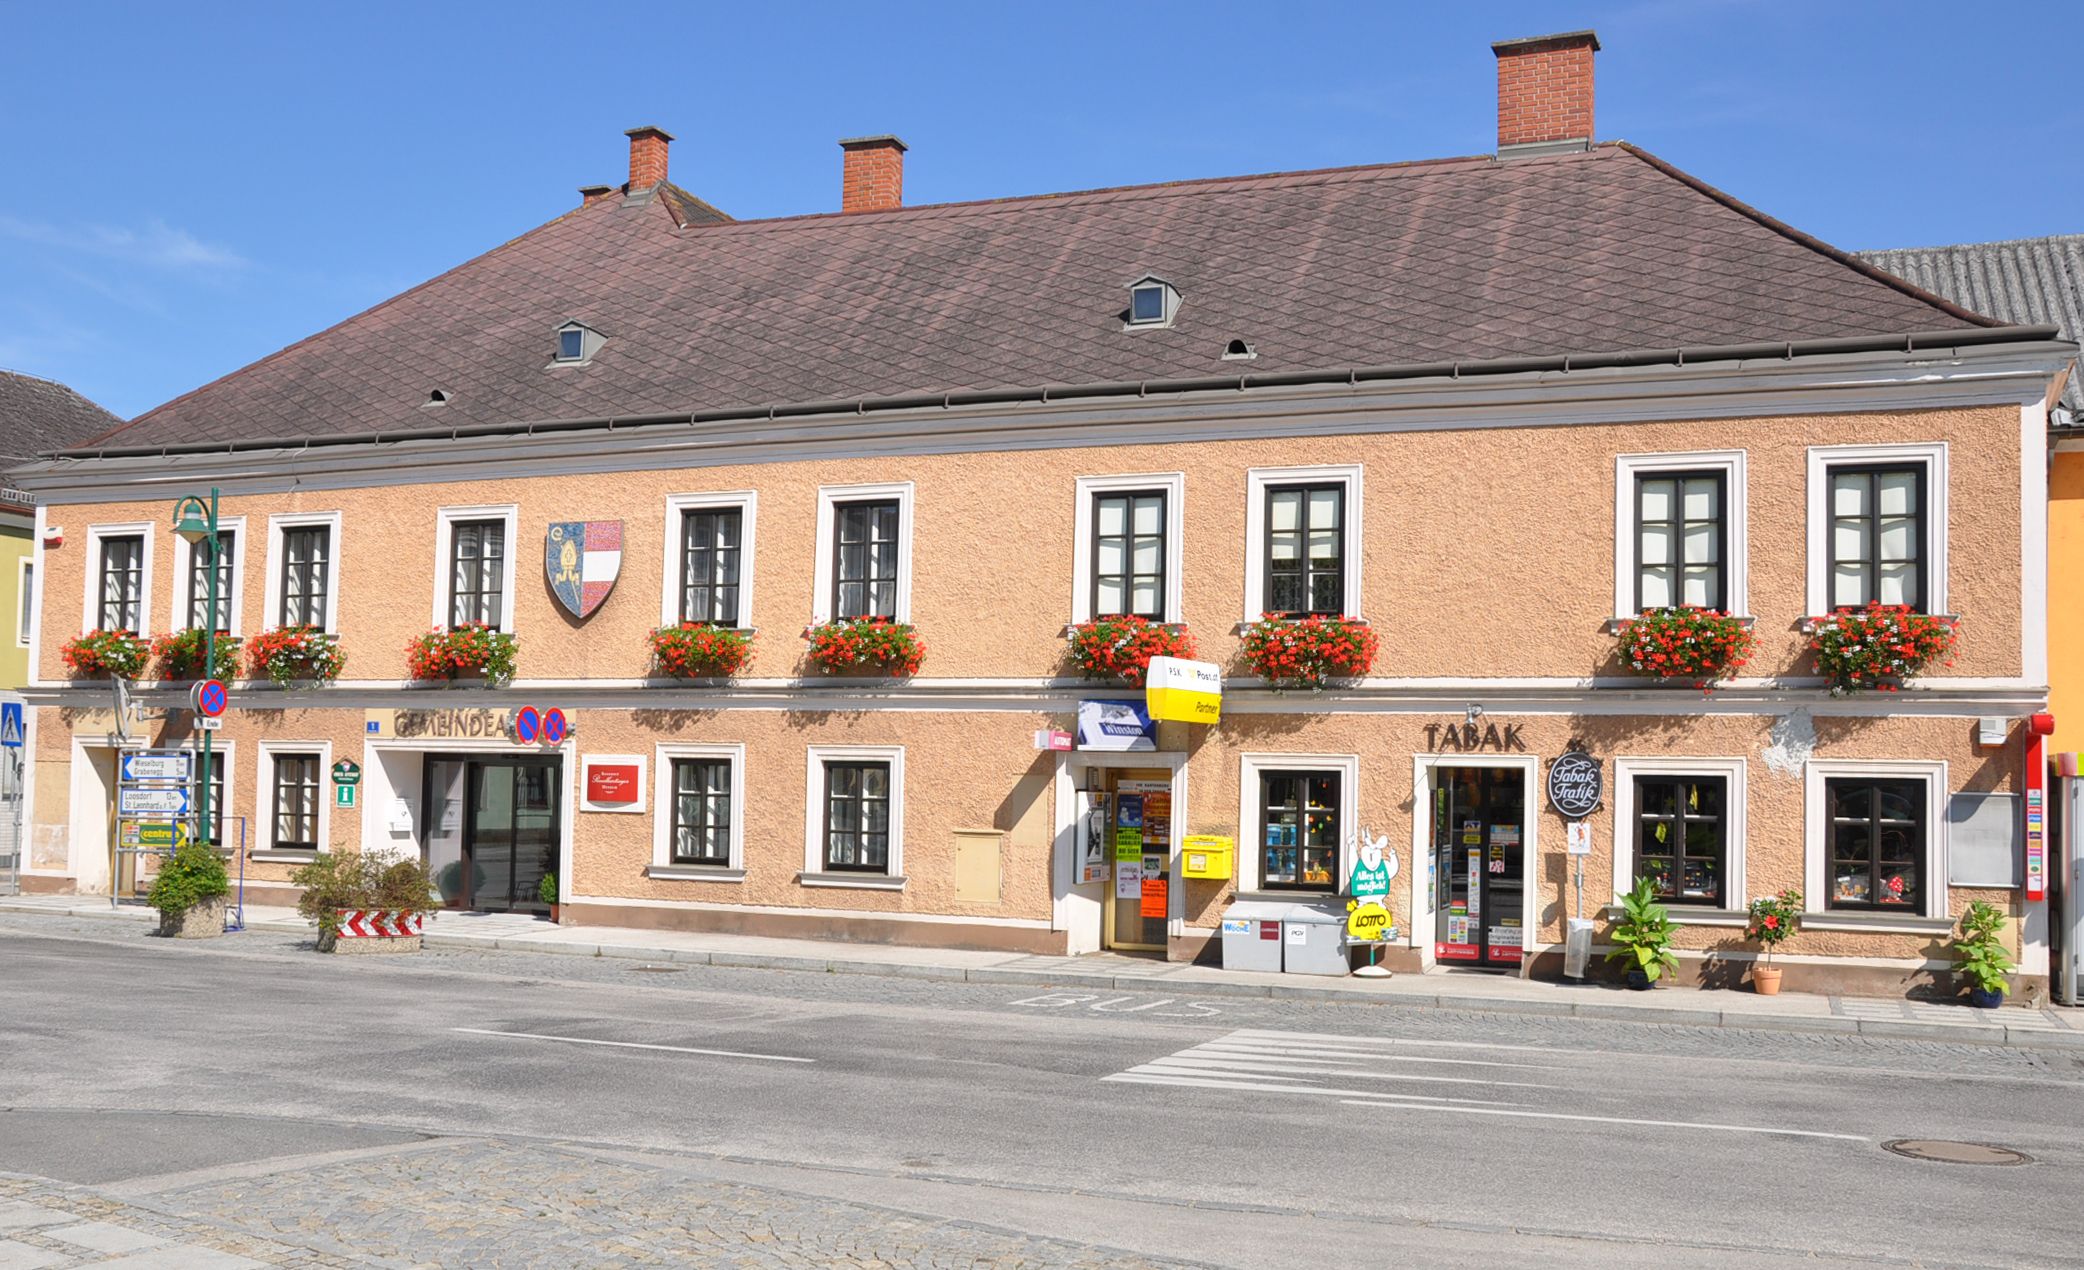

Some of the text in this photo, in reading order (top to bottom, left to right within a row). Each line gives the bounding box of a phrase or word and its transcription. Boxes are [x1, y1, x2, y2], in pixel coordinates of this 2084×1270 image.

[1195, 701, 1218, 714] Partner
[1103, 723, 1144, 735] Winston
[1423, 722, 1527, 752] TABAK
[134, 760, 165, 770] Wieselburg
[1553, 765, 1598, 783] Tabak
[125, 792, 153, 801] Loosdorf
[1553, 783, 1598, 802] Trafik
[1356, 870, 1386, 881] Alles ist
[1356, 880, 1387, 895] möglich!
[1355, 914, 1387, 928] LOTTO
[1007, 993, 1246, 1017] BUS
